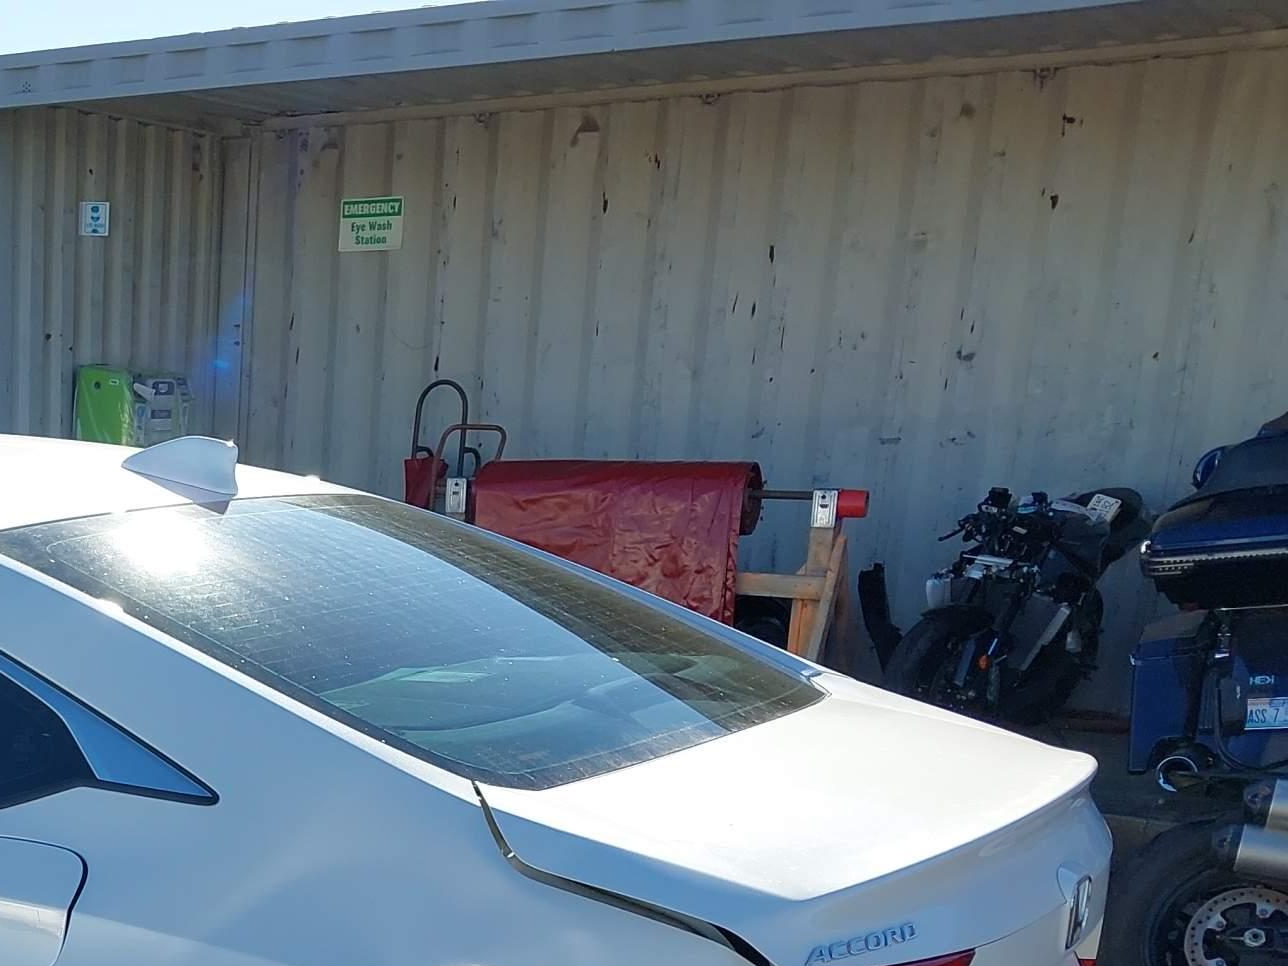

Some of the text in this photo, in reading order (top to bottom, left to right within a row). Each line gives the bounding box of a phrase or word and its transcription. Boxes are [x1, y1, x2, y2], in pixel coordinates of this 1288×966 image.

[344, 202, 400, 215] EMERGENCY
[351, 220, 392, 234] Eye Wash
[355, 235, 387, 245] Station
[804, 923, 918, 966] ACCORD
